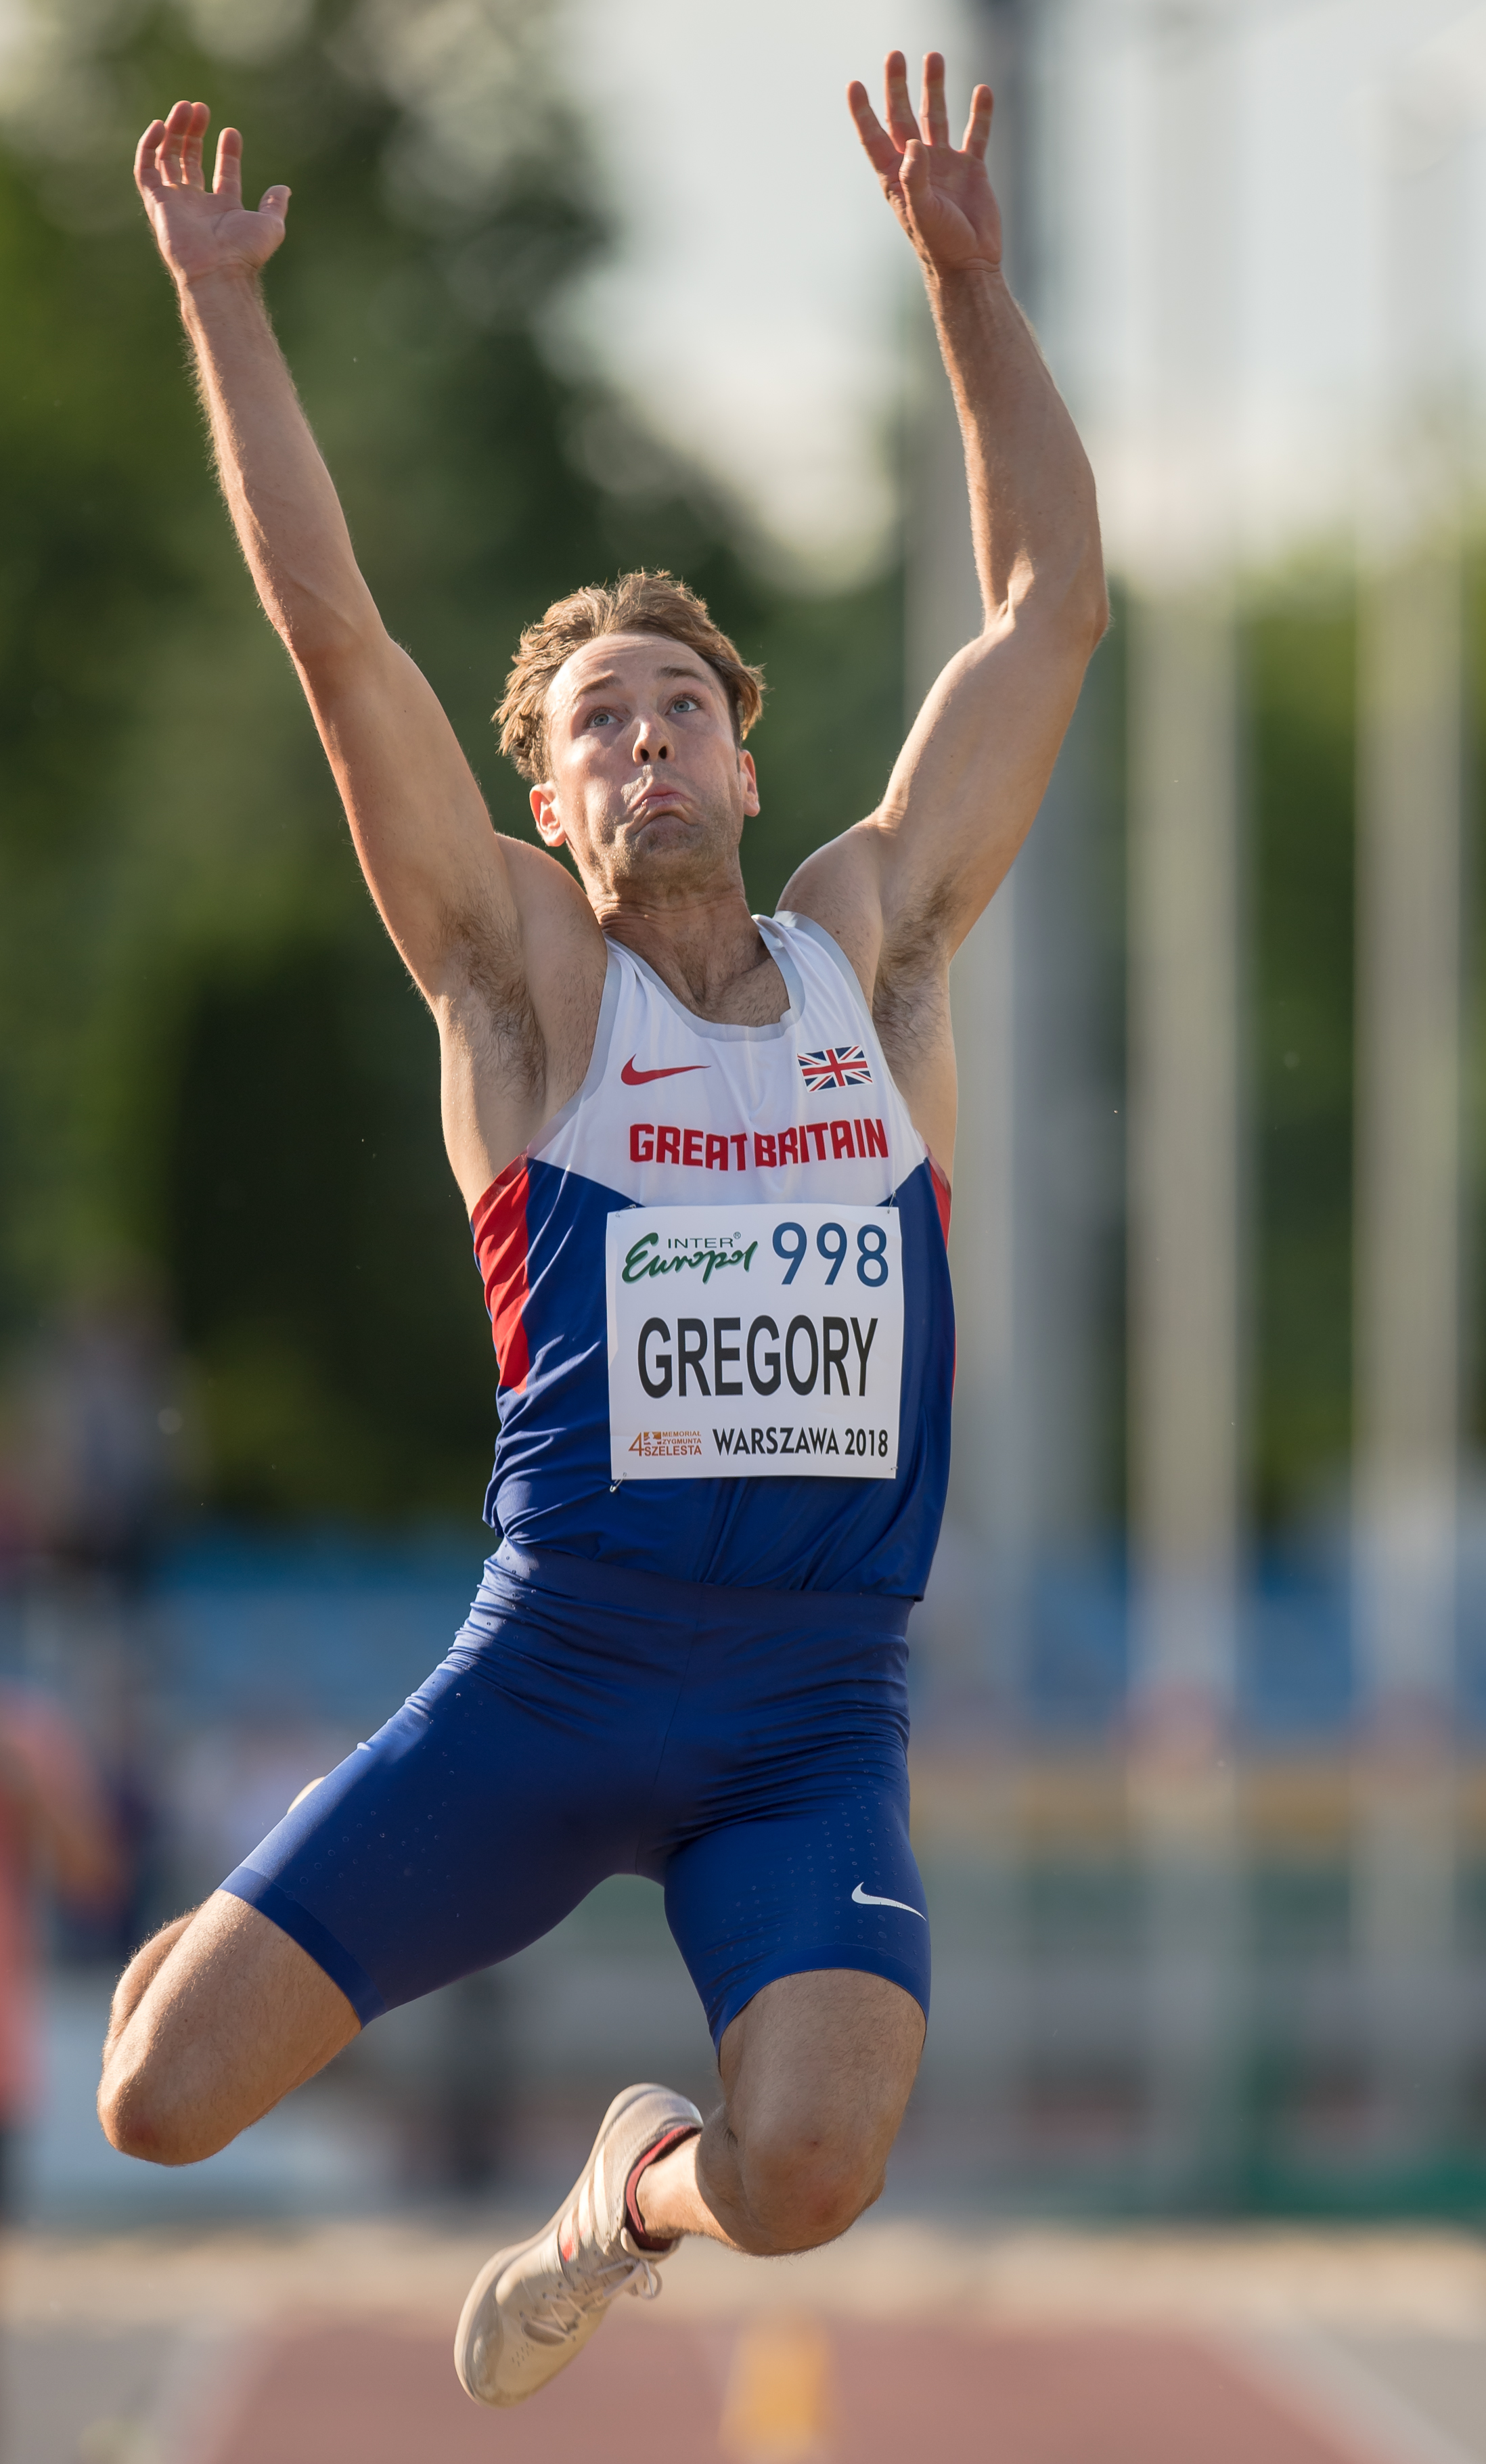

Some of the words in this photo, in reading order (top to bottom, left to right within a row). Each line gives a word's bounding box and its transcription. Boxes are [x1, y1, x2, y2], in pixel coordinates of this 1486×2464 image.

[629, 1123, 748, 1171] GREAT
[754, 1118, 888, 1168] BRITAIN
[622, 1232, 758, 1284] Europol
[668, 1238, 734, 1249] INTER
[772, 1222, 889, 1287] 998
[637, 1315, 878, 1398] GREGORY
[644, 1445, 702, 1456] SZELESTA
[712, 1427, 840, 1456] WARSZAWA
[845, 1428, 888, 1458] 2018
